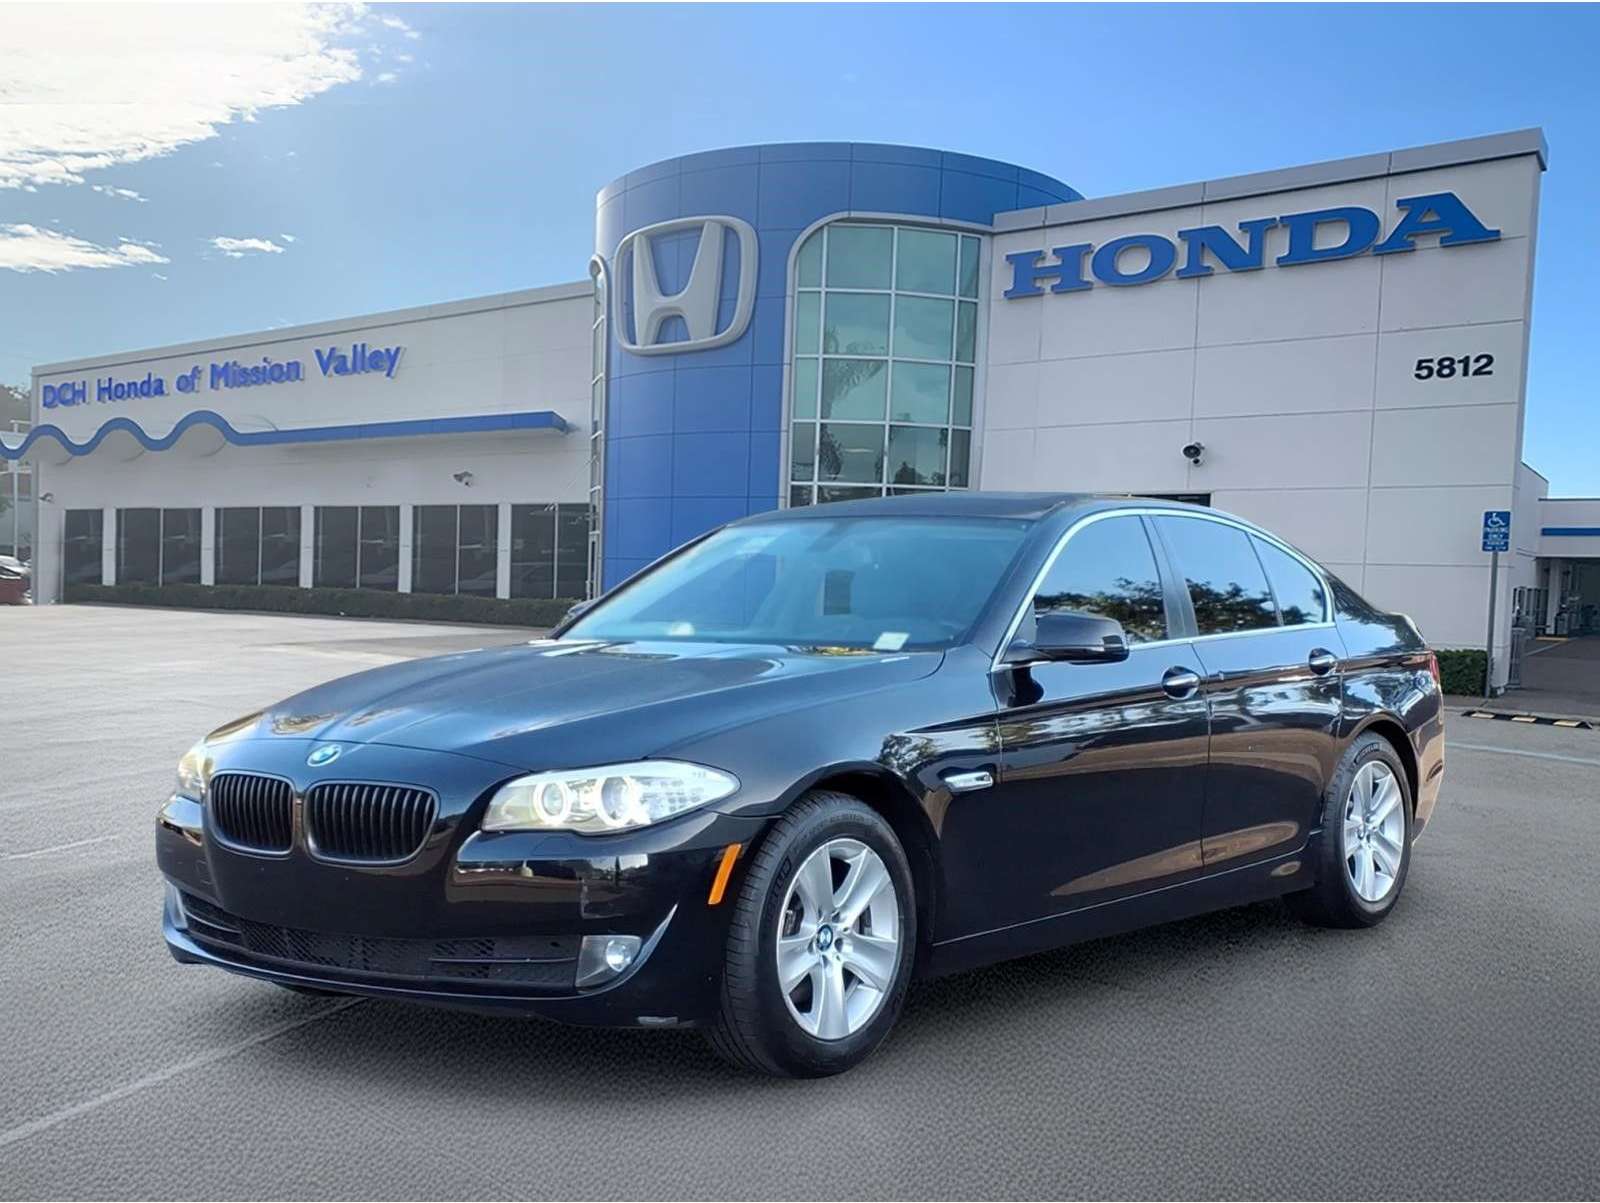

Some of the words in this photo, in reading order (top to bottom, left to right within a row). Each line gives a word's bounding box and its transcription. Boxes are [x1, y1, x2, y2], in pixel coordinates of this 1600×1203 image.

[1003, 191, 1501, 300] HONDA
[42, 380, 86, 409] DCH
[97, 372, 165, 402] Honda
[175, 365, 201, 393] of
[209, 357, 303, 390] Mission
[314, 343, 402, 378] Valley
[1414, 353, 1495, 380] 5812
